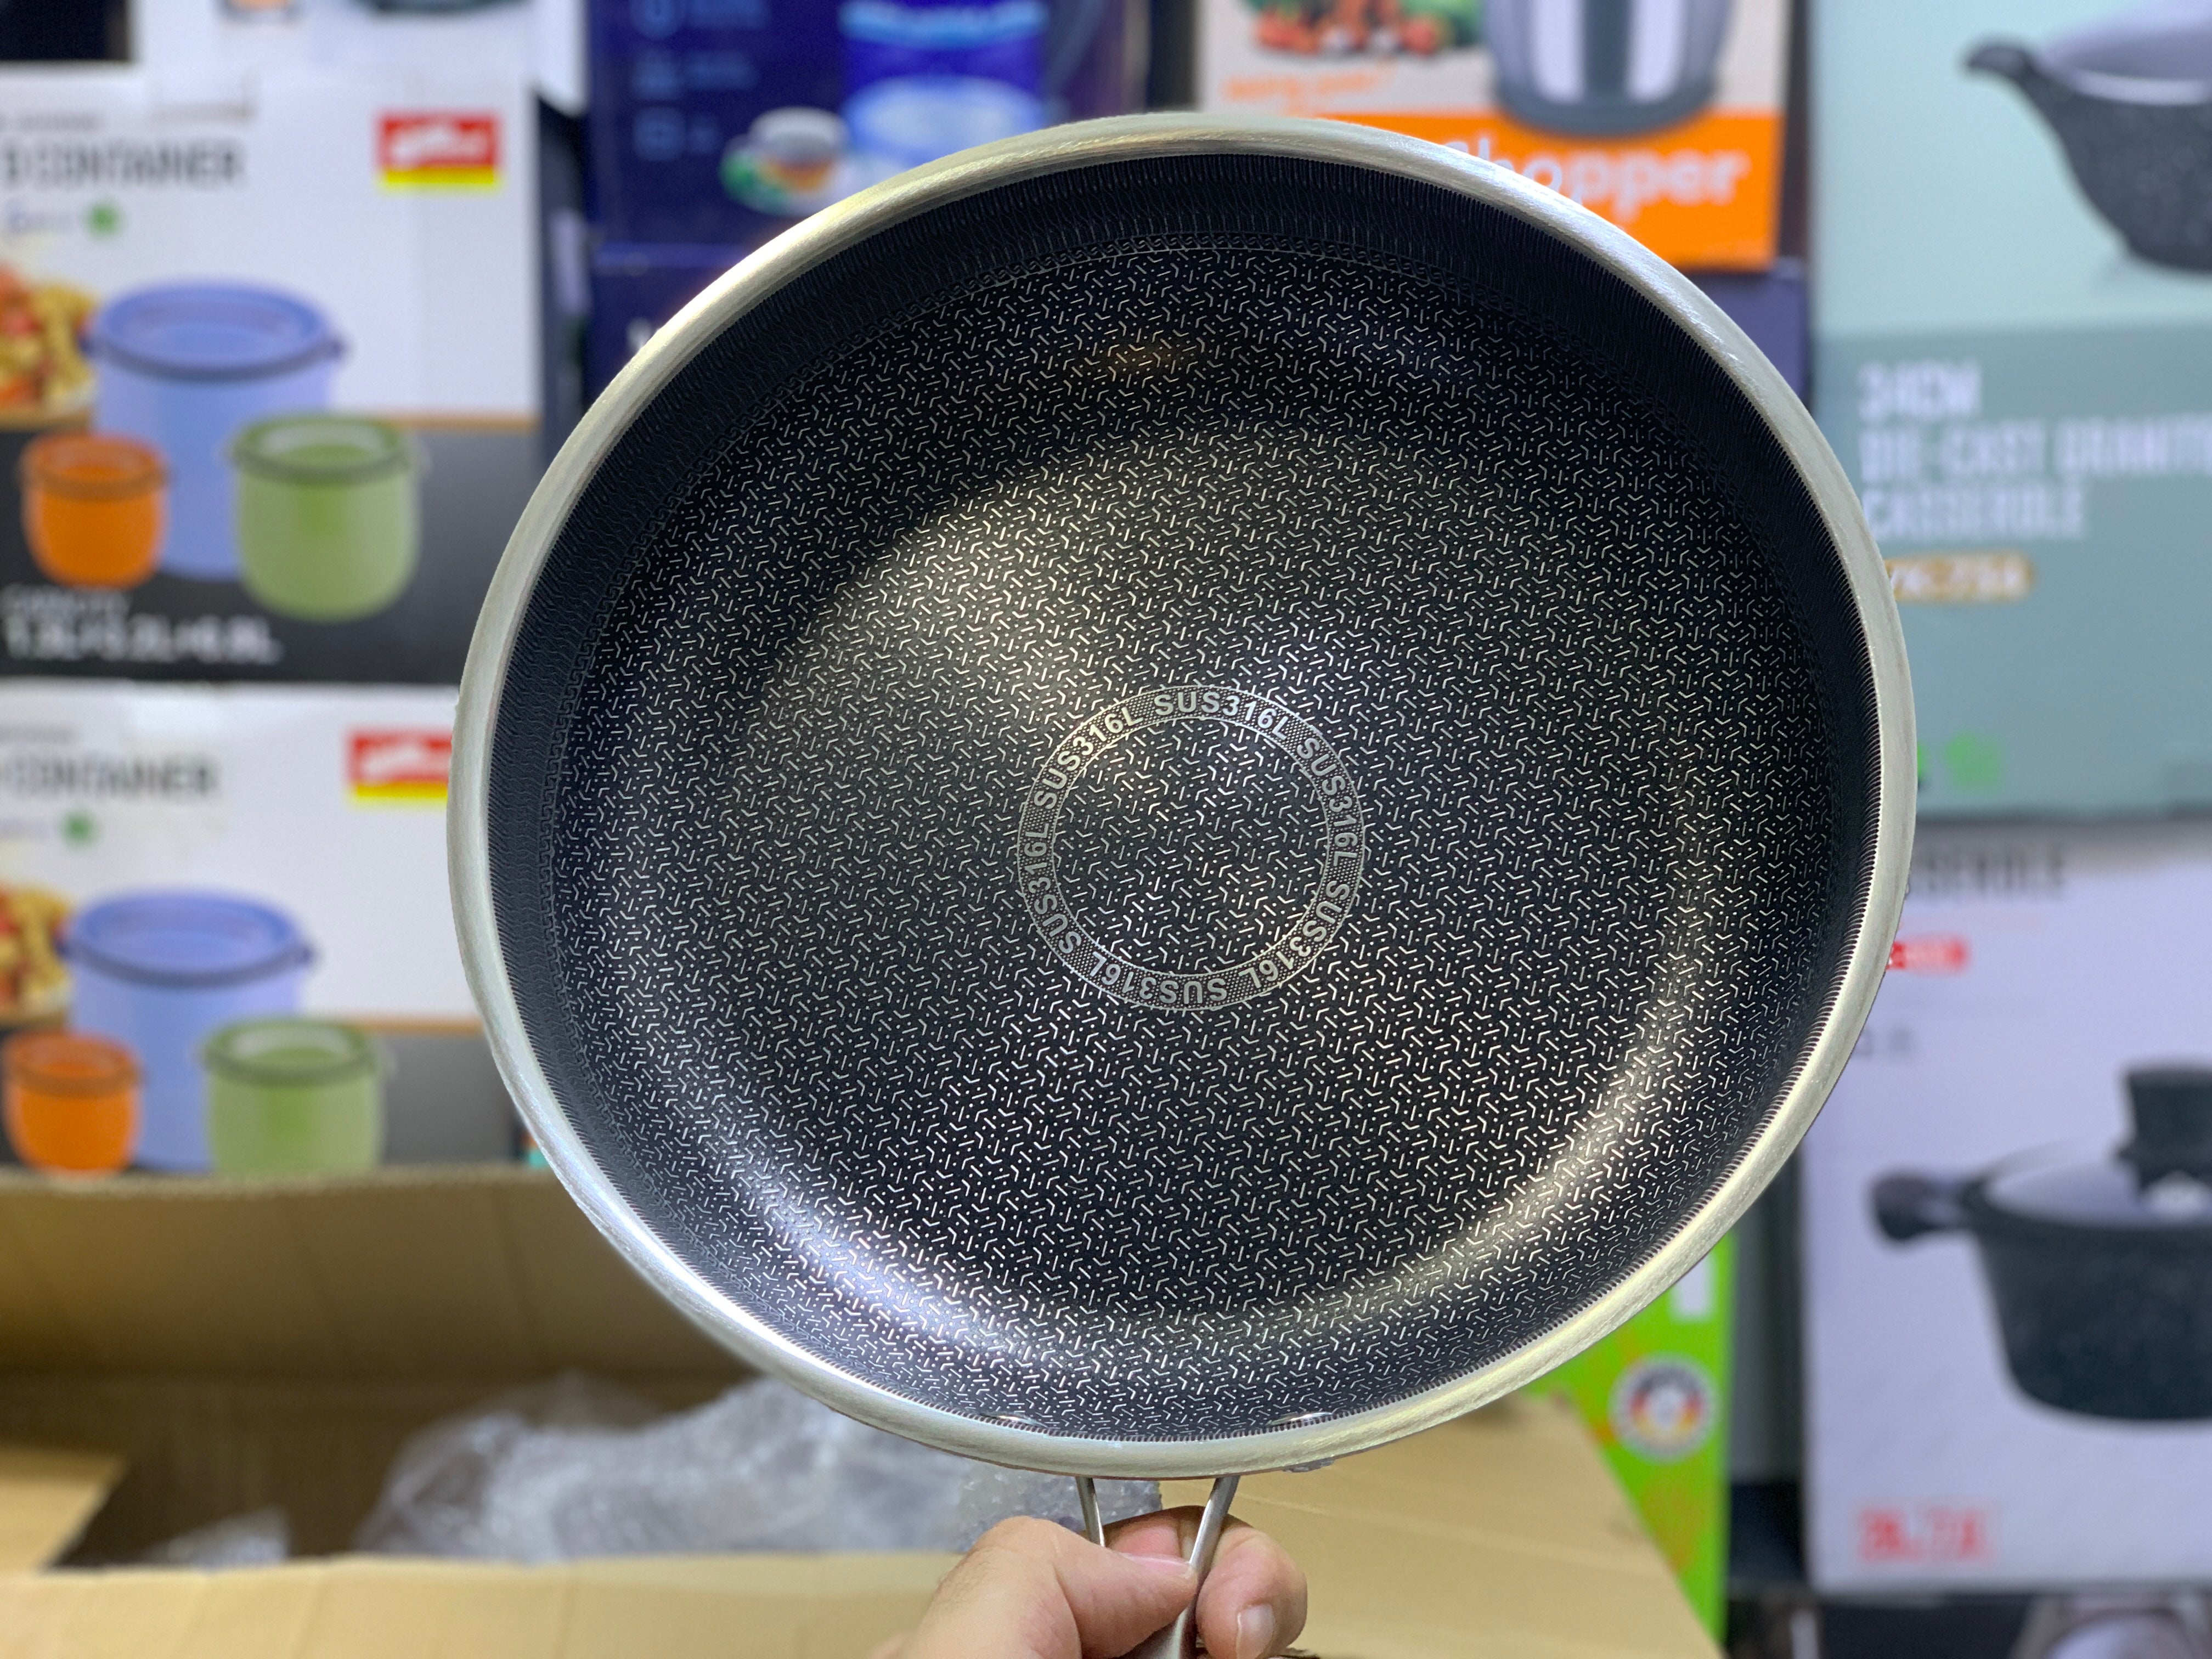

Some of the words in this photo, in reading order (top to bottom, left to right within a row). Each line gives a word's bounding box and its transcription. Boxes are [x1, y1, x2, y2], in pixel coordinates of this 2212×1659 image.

[1443, 137, 1751, 228] hopper
[1034, 706, 1144, 810] SUS316L
[1154, 691, 1291, 741] SUS316L
[1297, 737, 1358, 866] SUS316L
[1024, 823, 1082, 955] SUS316L
[1238, 880, 1350, 989] SUS316L
[1088, 951, 1228, 1005] SUS316L
